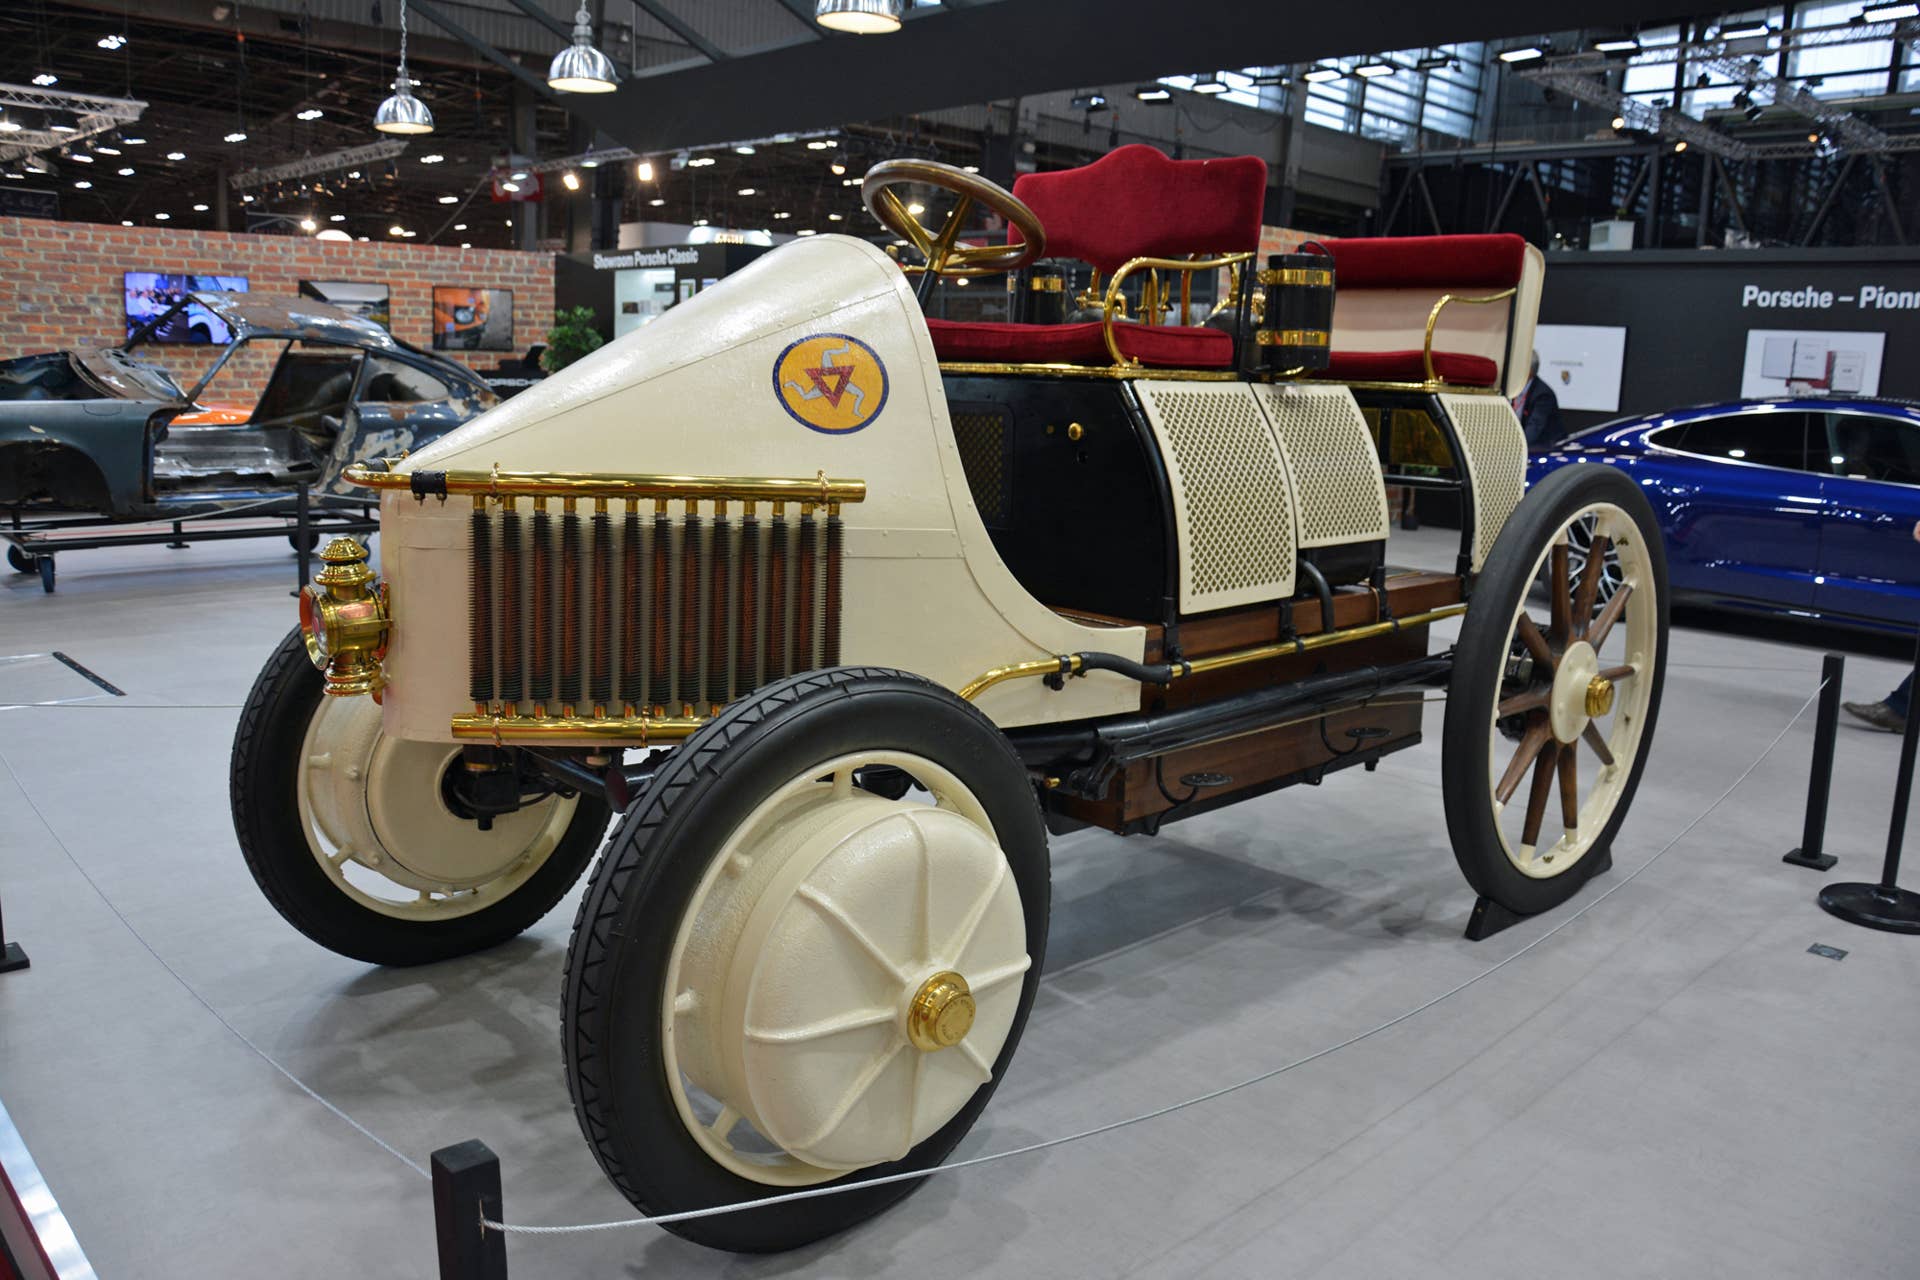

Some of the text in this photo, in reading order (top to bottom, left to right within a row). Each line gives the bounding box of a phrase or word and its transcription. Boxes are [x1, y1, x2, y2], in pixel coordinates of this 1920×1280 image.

[593, 246, 699, 270] Showroom Porsche Classic
[1742, 285, 1833, 308] Porsche
